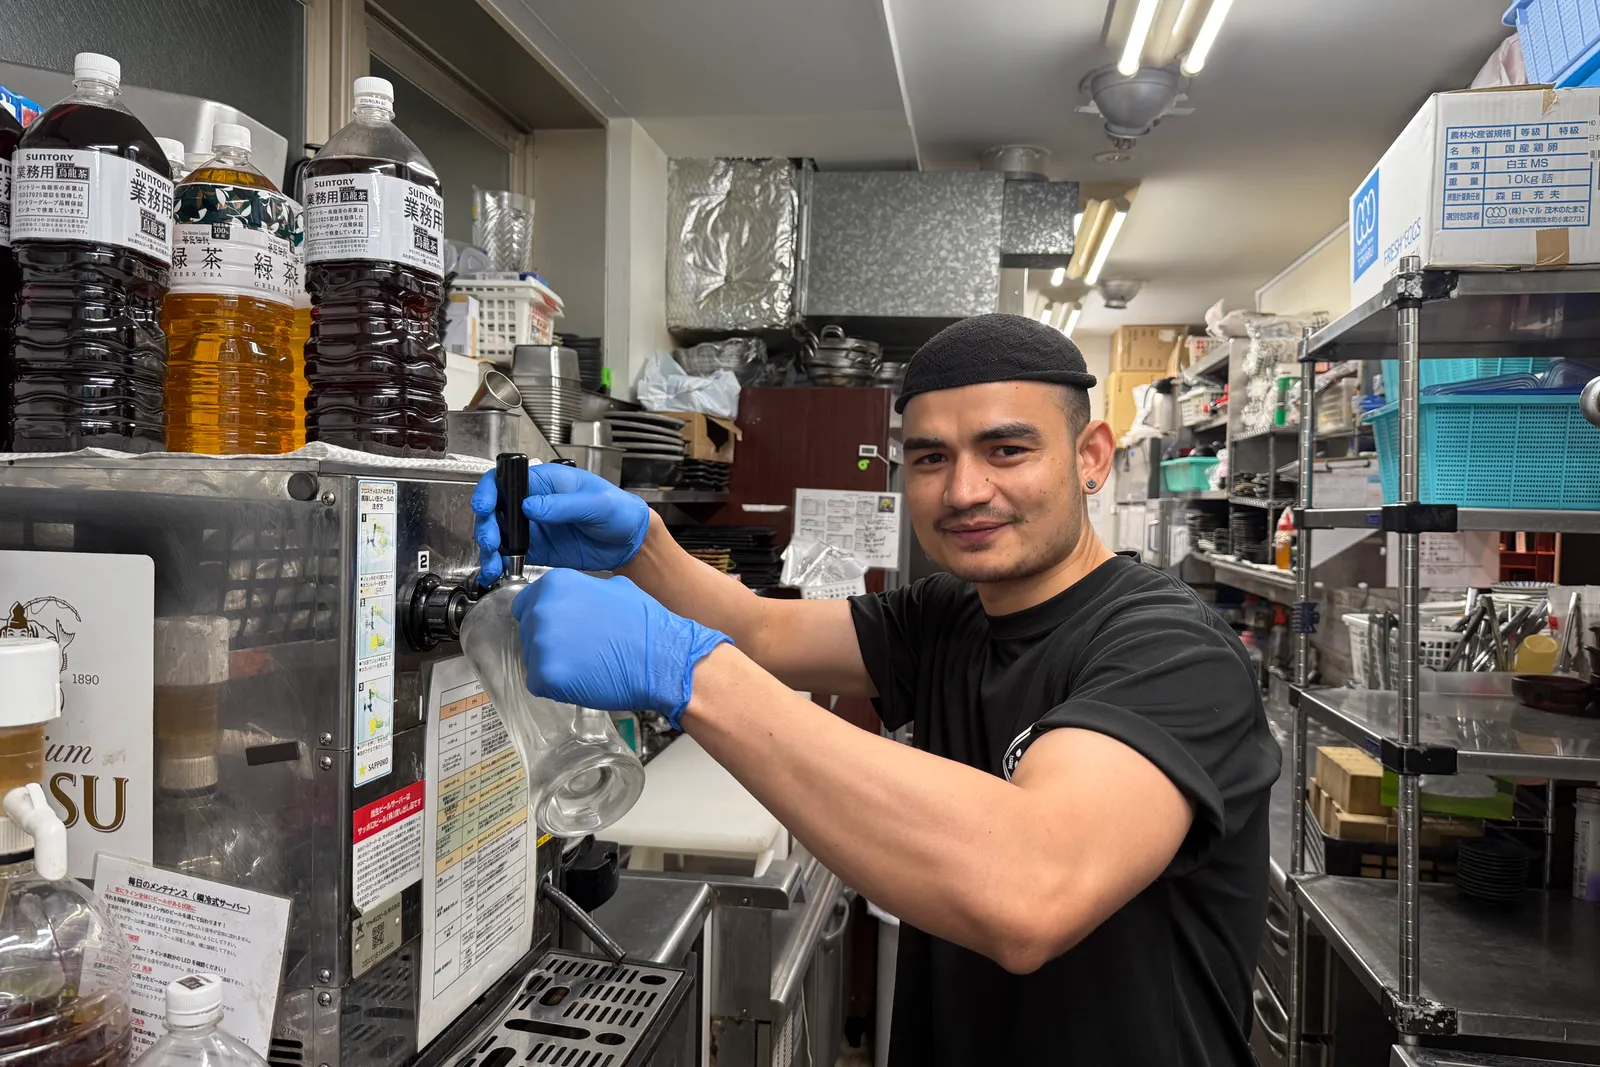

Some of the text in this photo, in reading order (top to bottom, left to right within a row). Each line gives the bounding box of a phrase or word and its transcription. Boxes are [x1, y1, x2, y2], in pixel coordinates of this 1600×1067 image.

[1450, 126, 1579, 140] 農林水産省規格 等級 特級
[1450, 142, 1558, 155] 名称 国産鶏卵
[1450, 162, 1480, 170] 種類
[1507, 158, 1548, 169] 白玉 MS
[16, 164, 54, 180] 業務用
[58, 168, 88, 180] 烏龍茶
[136, 168, 171, 194] SUNTORY
[314, 178, 354, 188] SUNTORY
[1448, 173, 1554, 186] 重量 10kg 詰
[130, 178, 172, 218] 業務用
[306, 190, 338, 206] 業務用
[342, 192, 367, 200] 烏龍茶
[408, 186, 442, 208] SUNTORY
[1496, 192, 1521, 200] 森田
[404, 196, 442, 233] 業務用
[1446, 212, 1480, 220] 選別包装者
[1544, 206, 1586, 214] 茂木のたまご
[1384, 216, 1421, 268] FRESH EGGS
[172, 247, 223, 270] 緑茶
[254, 281, 280, 292] GREEN
[420, 554, 428, 568] 2
[72, 674, 100, 685] 1890
[45, 736, 94, 764] ium
[368, 757, 388, 772] SAPPORO
[49, 772, 130, 833] SU
[181, 956, 192, 964] LED
[132, 974, 169, 986] に残ったビールは
[132, 1008, 166, 1022] 開店前にグラス
